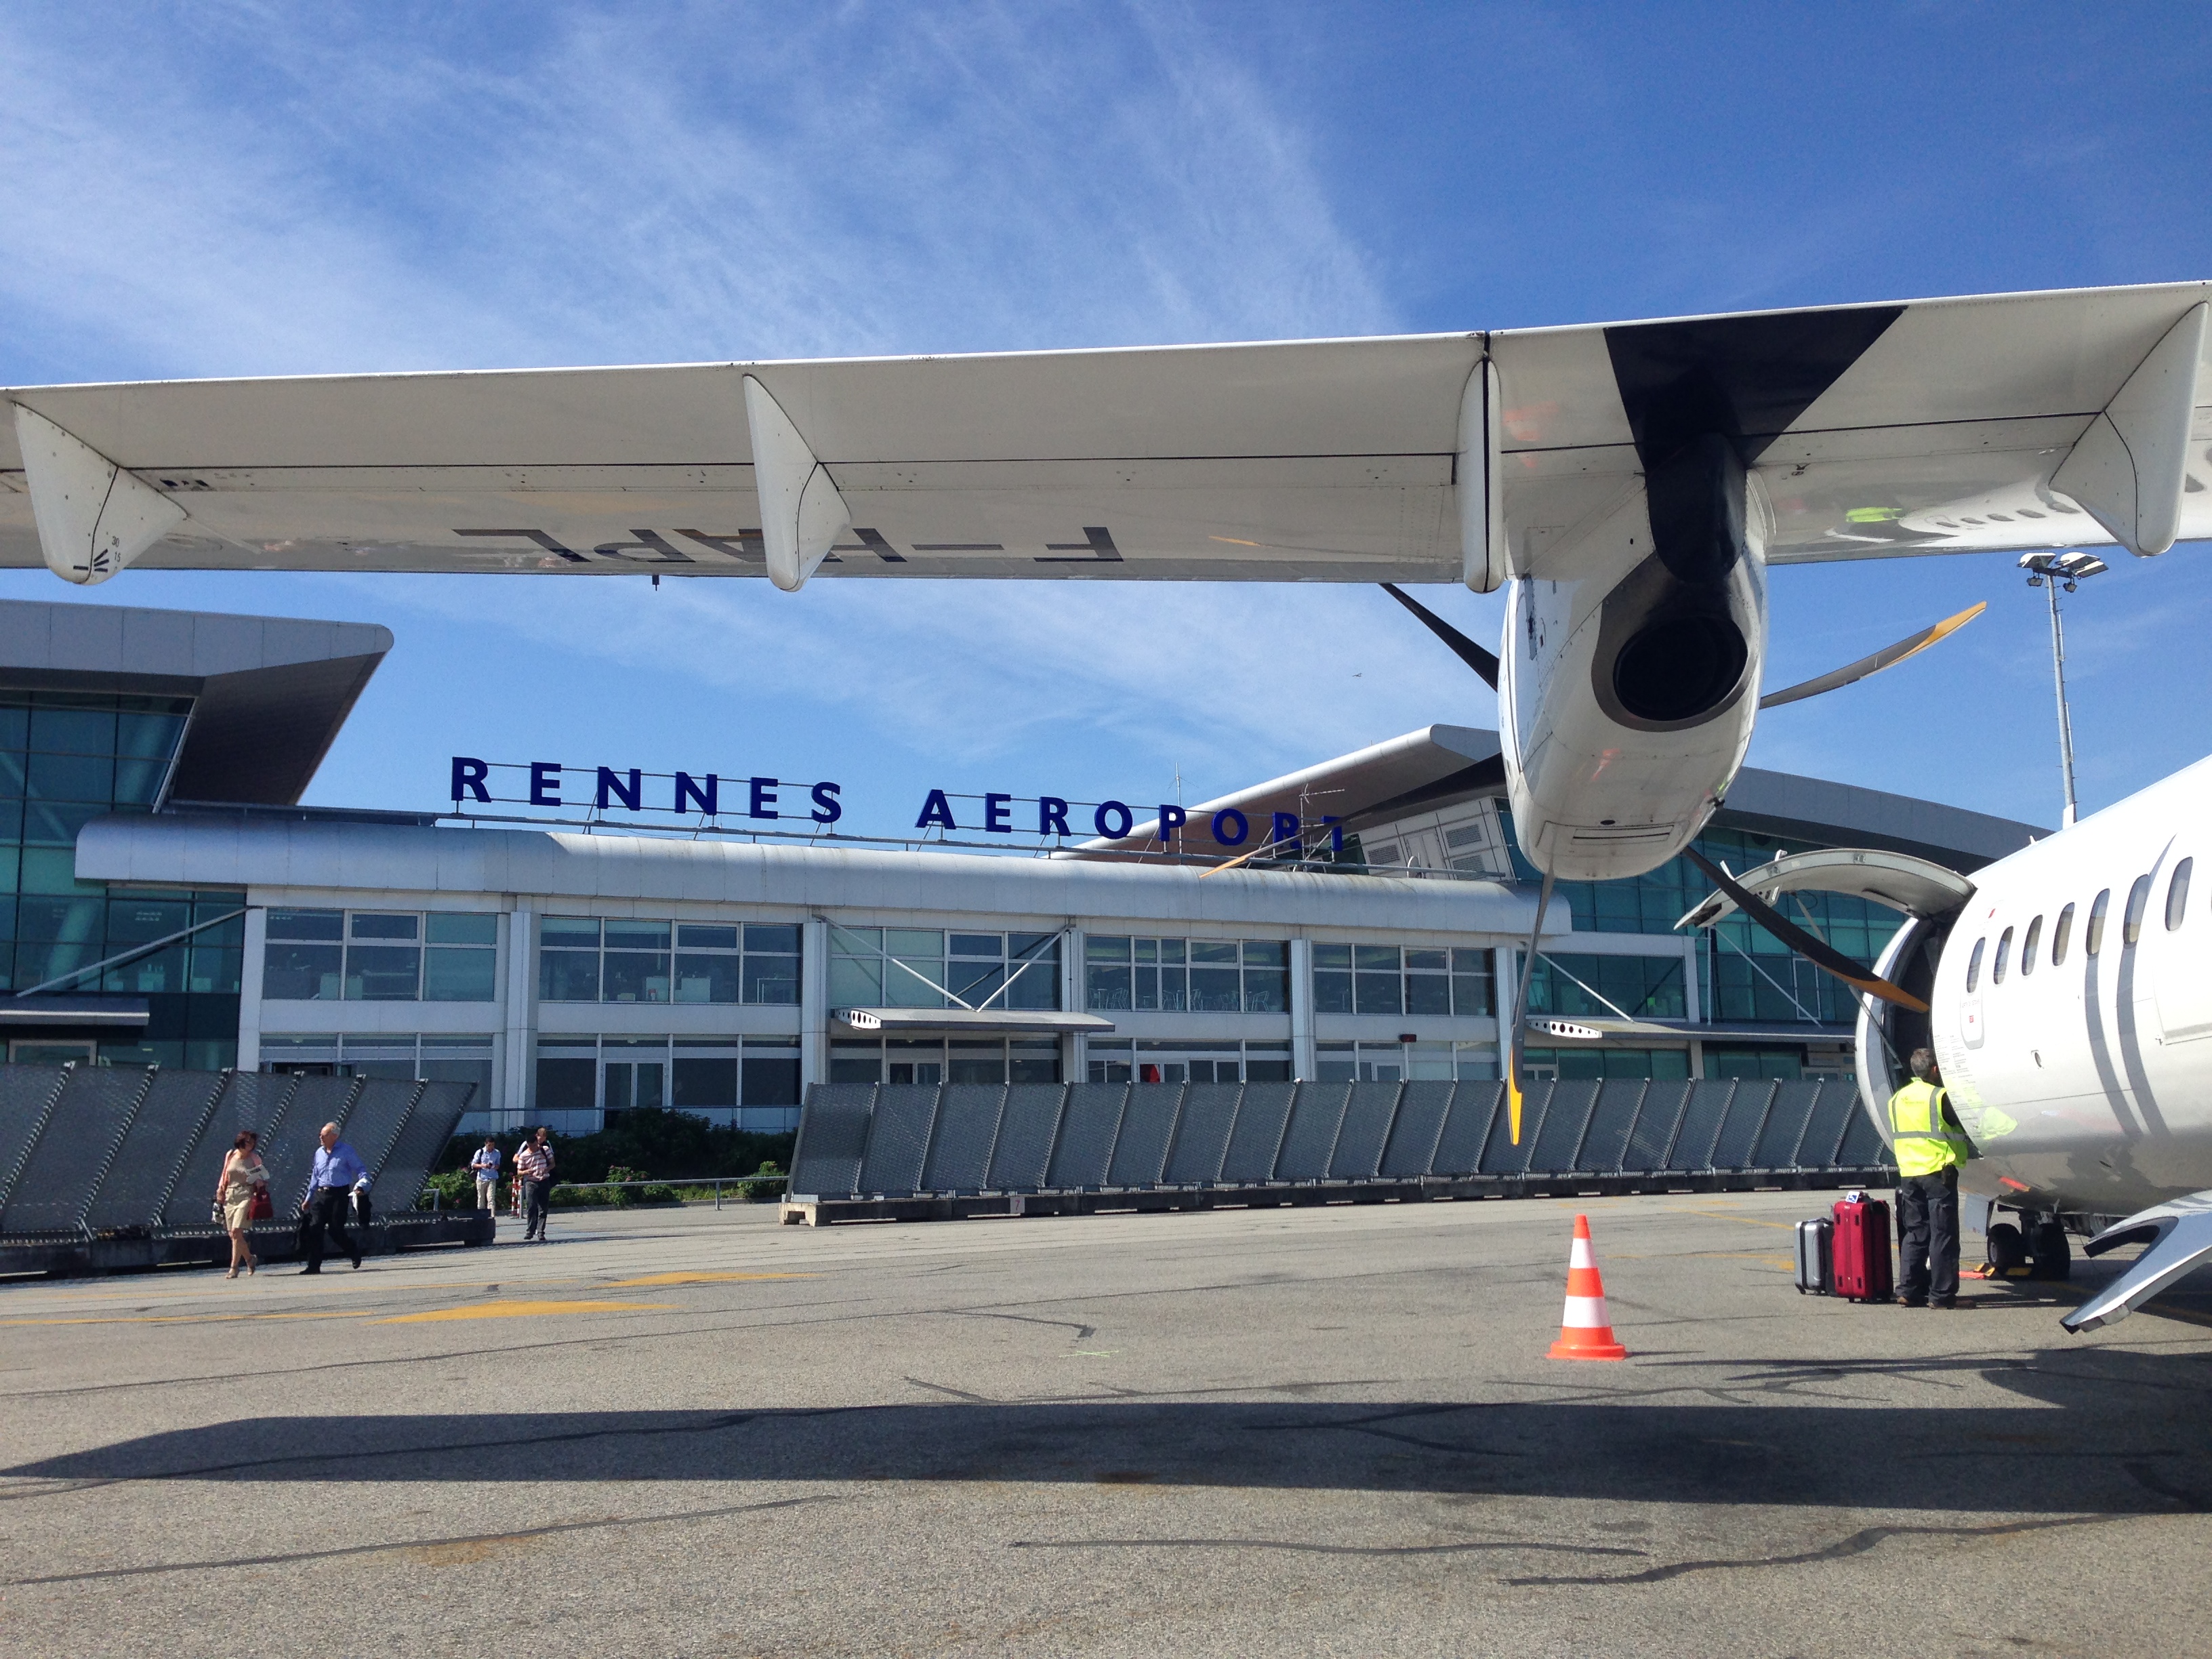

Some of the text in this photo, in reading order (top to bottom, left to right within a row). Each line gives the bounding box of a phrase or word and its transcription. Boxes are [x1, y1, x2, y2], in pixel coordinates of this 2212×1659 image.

[112, 535, 120, 548] 30
[115, 551, 121, 562] 15
[451, 756, 1343, 852] RENNES AEROPORT
